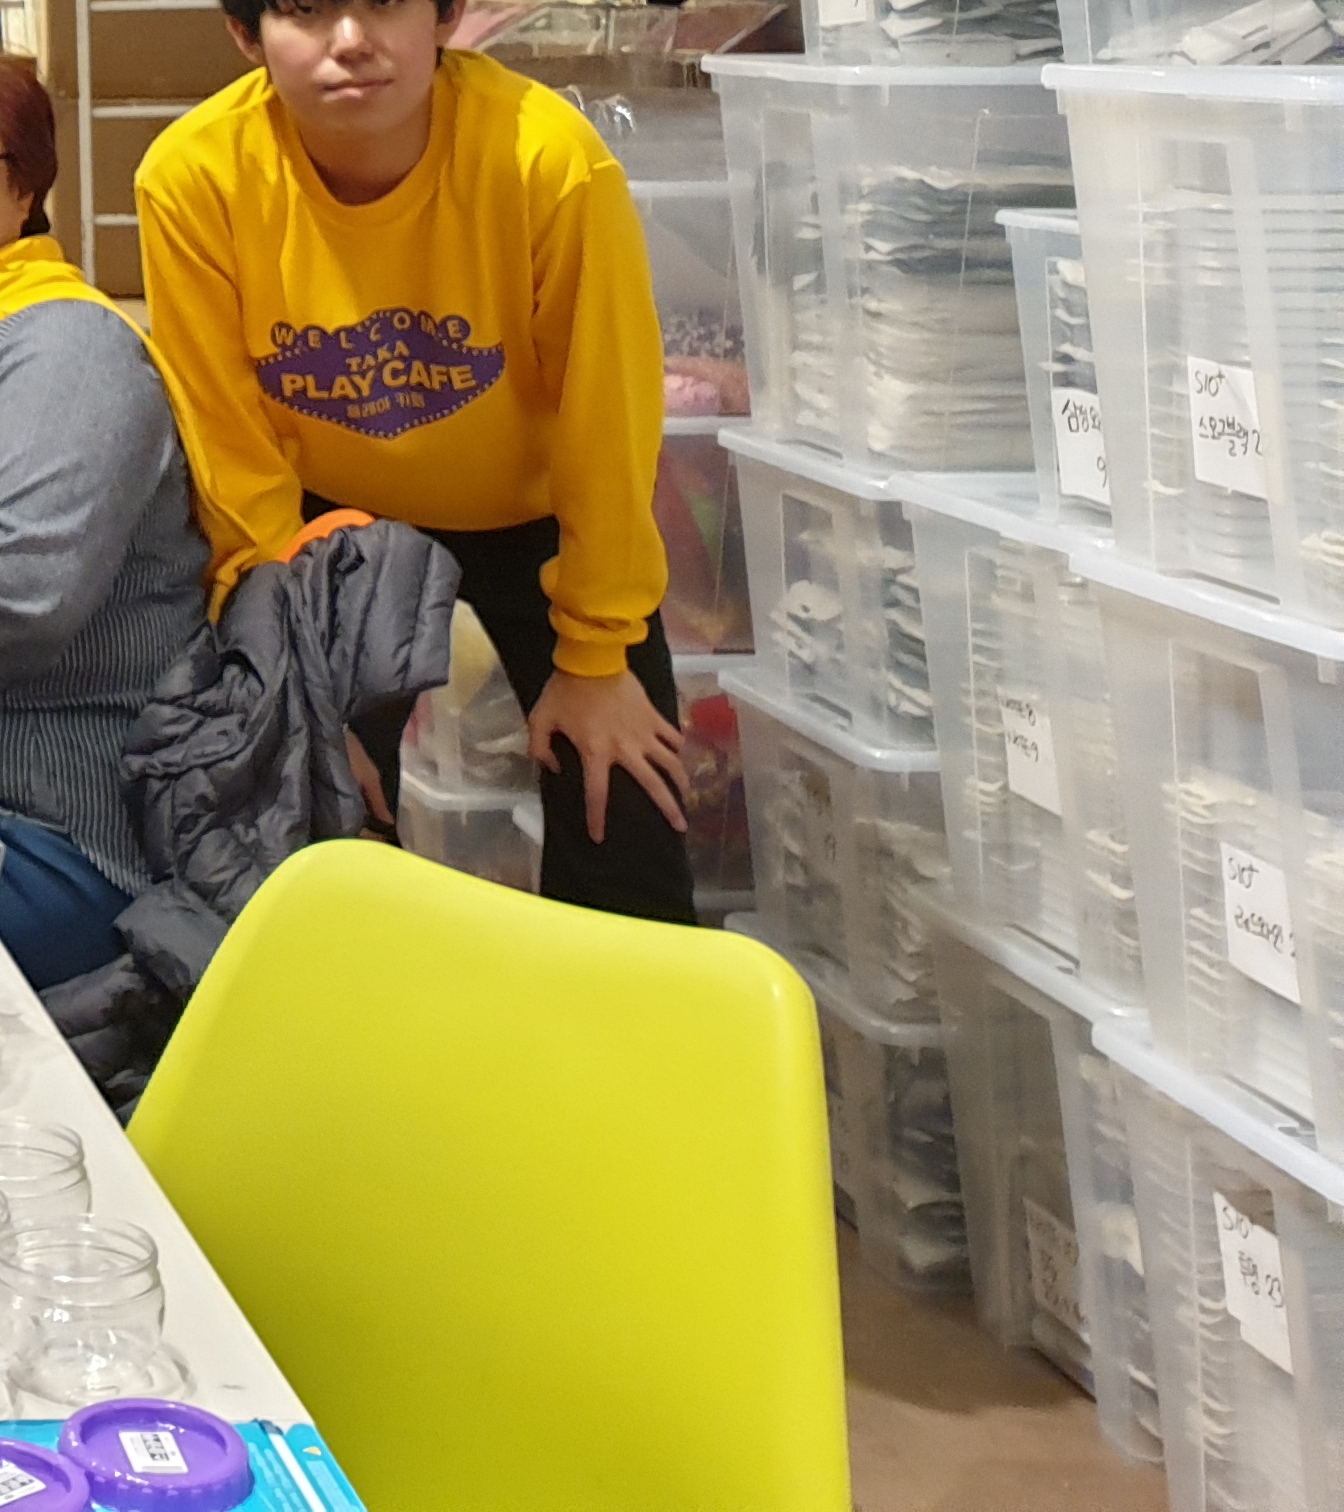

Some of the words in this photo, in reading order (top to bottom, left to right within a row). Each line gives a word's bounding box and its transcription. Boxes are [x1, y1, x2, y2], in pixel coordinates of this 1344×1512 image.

[274, 310, 462, 349] WELCOME
[345, 340, 409, 373] TAKA
[280, 369, 375, 400] PLAY
[381, 359, 477, 391] CAFE
